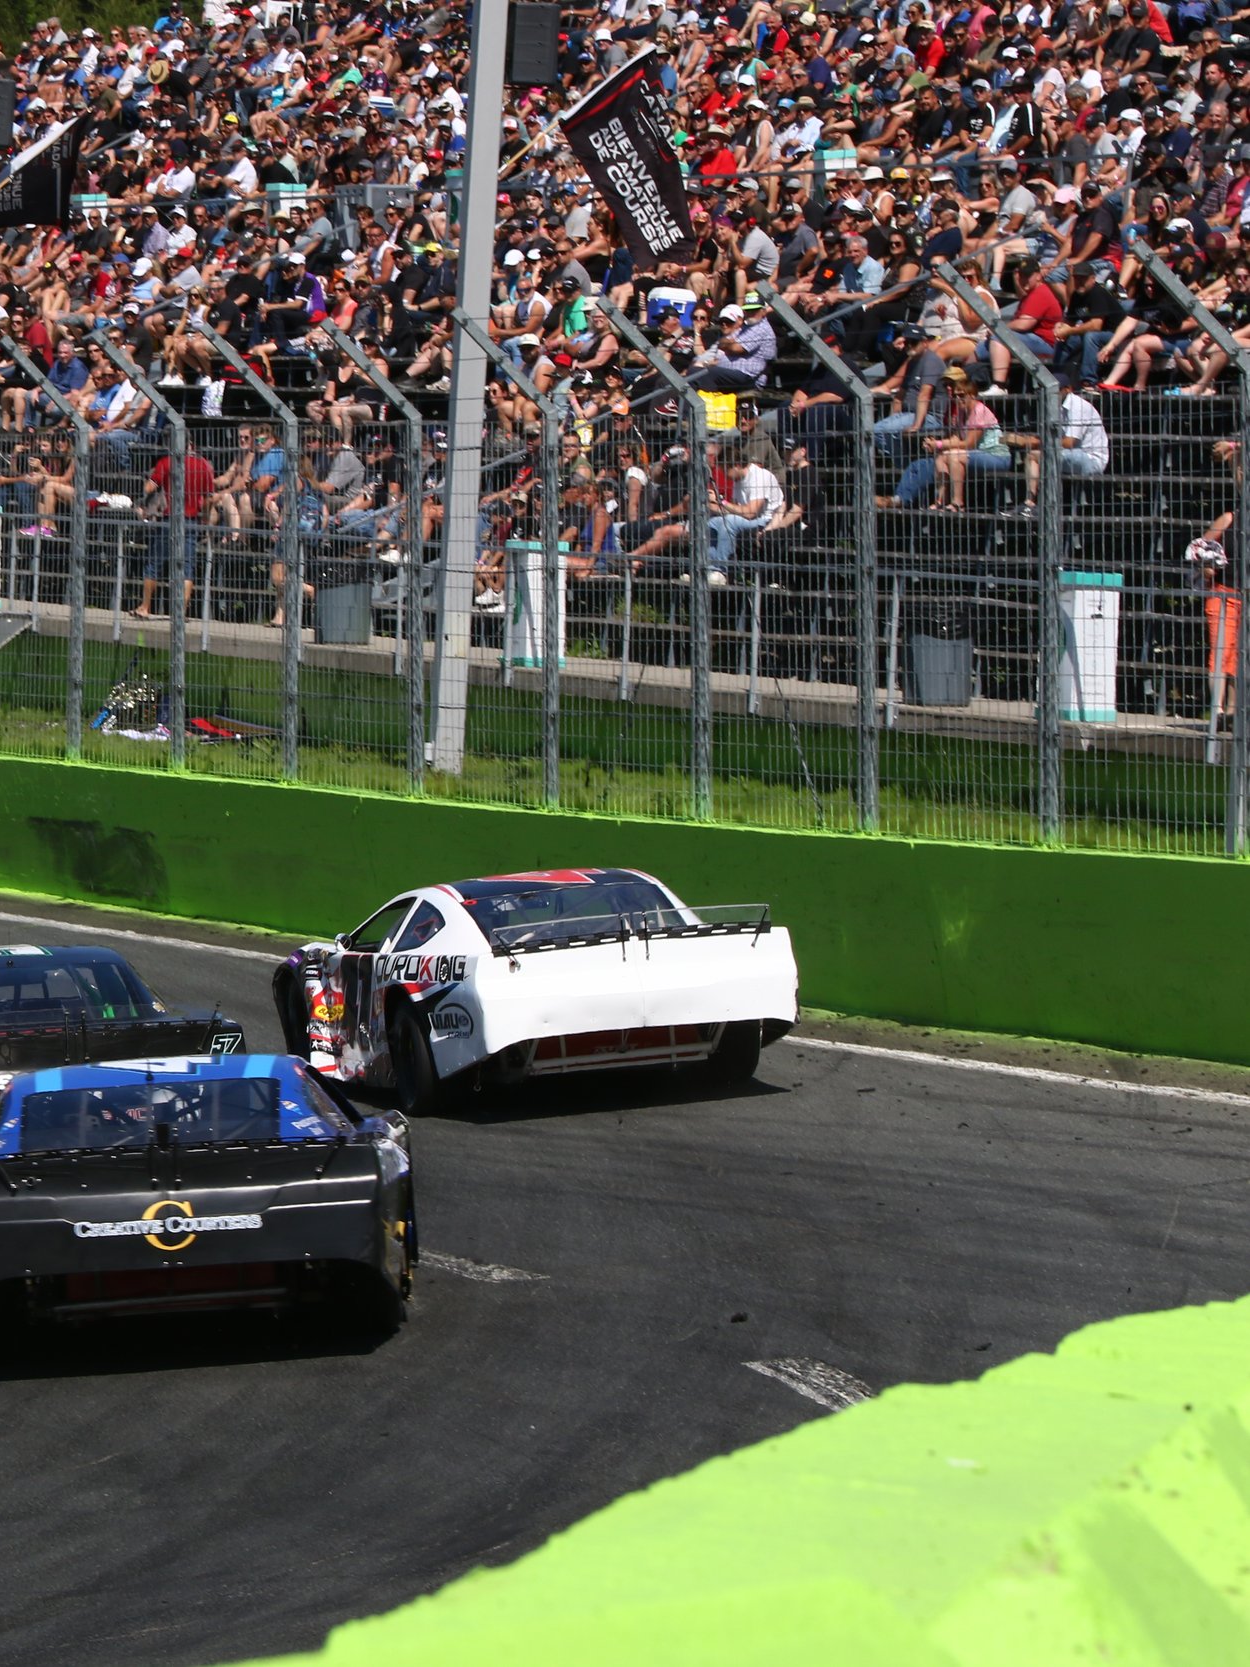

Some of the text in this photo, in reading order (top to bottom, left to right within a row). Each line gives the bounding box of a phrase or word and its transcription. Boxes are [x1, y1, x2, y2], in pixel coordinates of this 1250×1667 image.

[588, 131, 611, 163] DE
[606, 165, 665, 256] COURSE
[600, 126, 622, 161] AUX
[617, 160, 672, 250] AMATEURS
[608, 116, 685, 244] BIENVENUE
[209, 1032, 243, 1056] 57
[73, 1218, 165, 1239] CREATIVE
